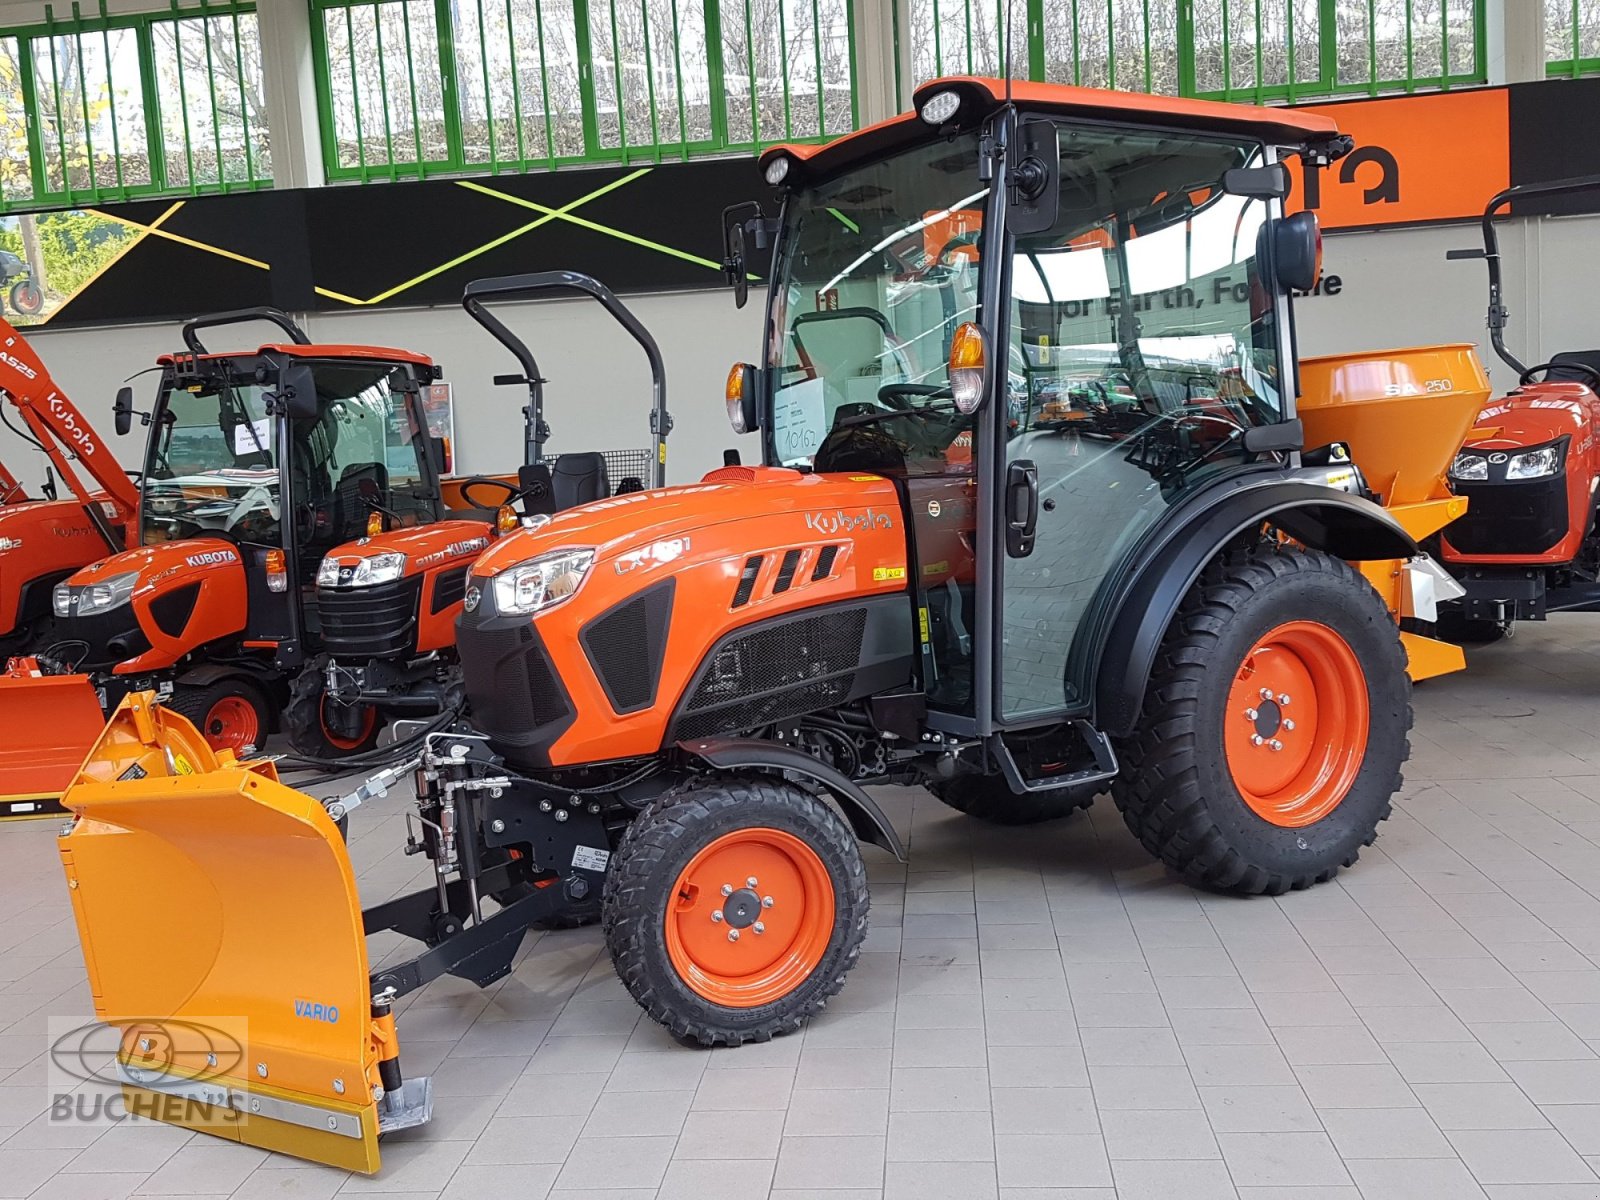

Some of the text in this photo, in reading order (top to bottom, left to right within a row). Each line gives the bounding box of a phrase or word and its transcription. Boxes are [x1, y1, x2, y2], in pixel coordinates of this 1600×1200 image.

[1105, 287, 1205, 316] Erth,
[1214, 276, 1248, 305] Fo
[1425, 379, 1452, 393] 250
[47, 391, 95, 456] Kubota
[804, 507, 893, 535] Kubota
[185, 550, 238, 567] KUBOTA
[446, 536, 490, 557] KUBOTA
[294, 999, 339, 1024] VARIO
